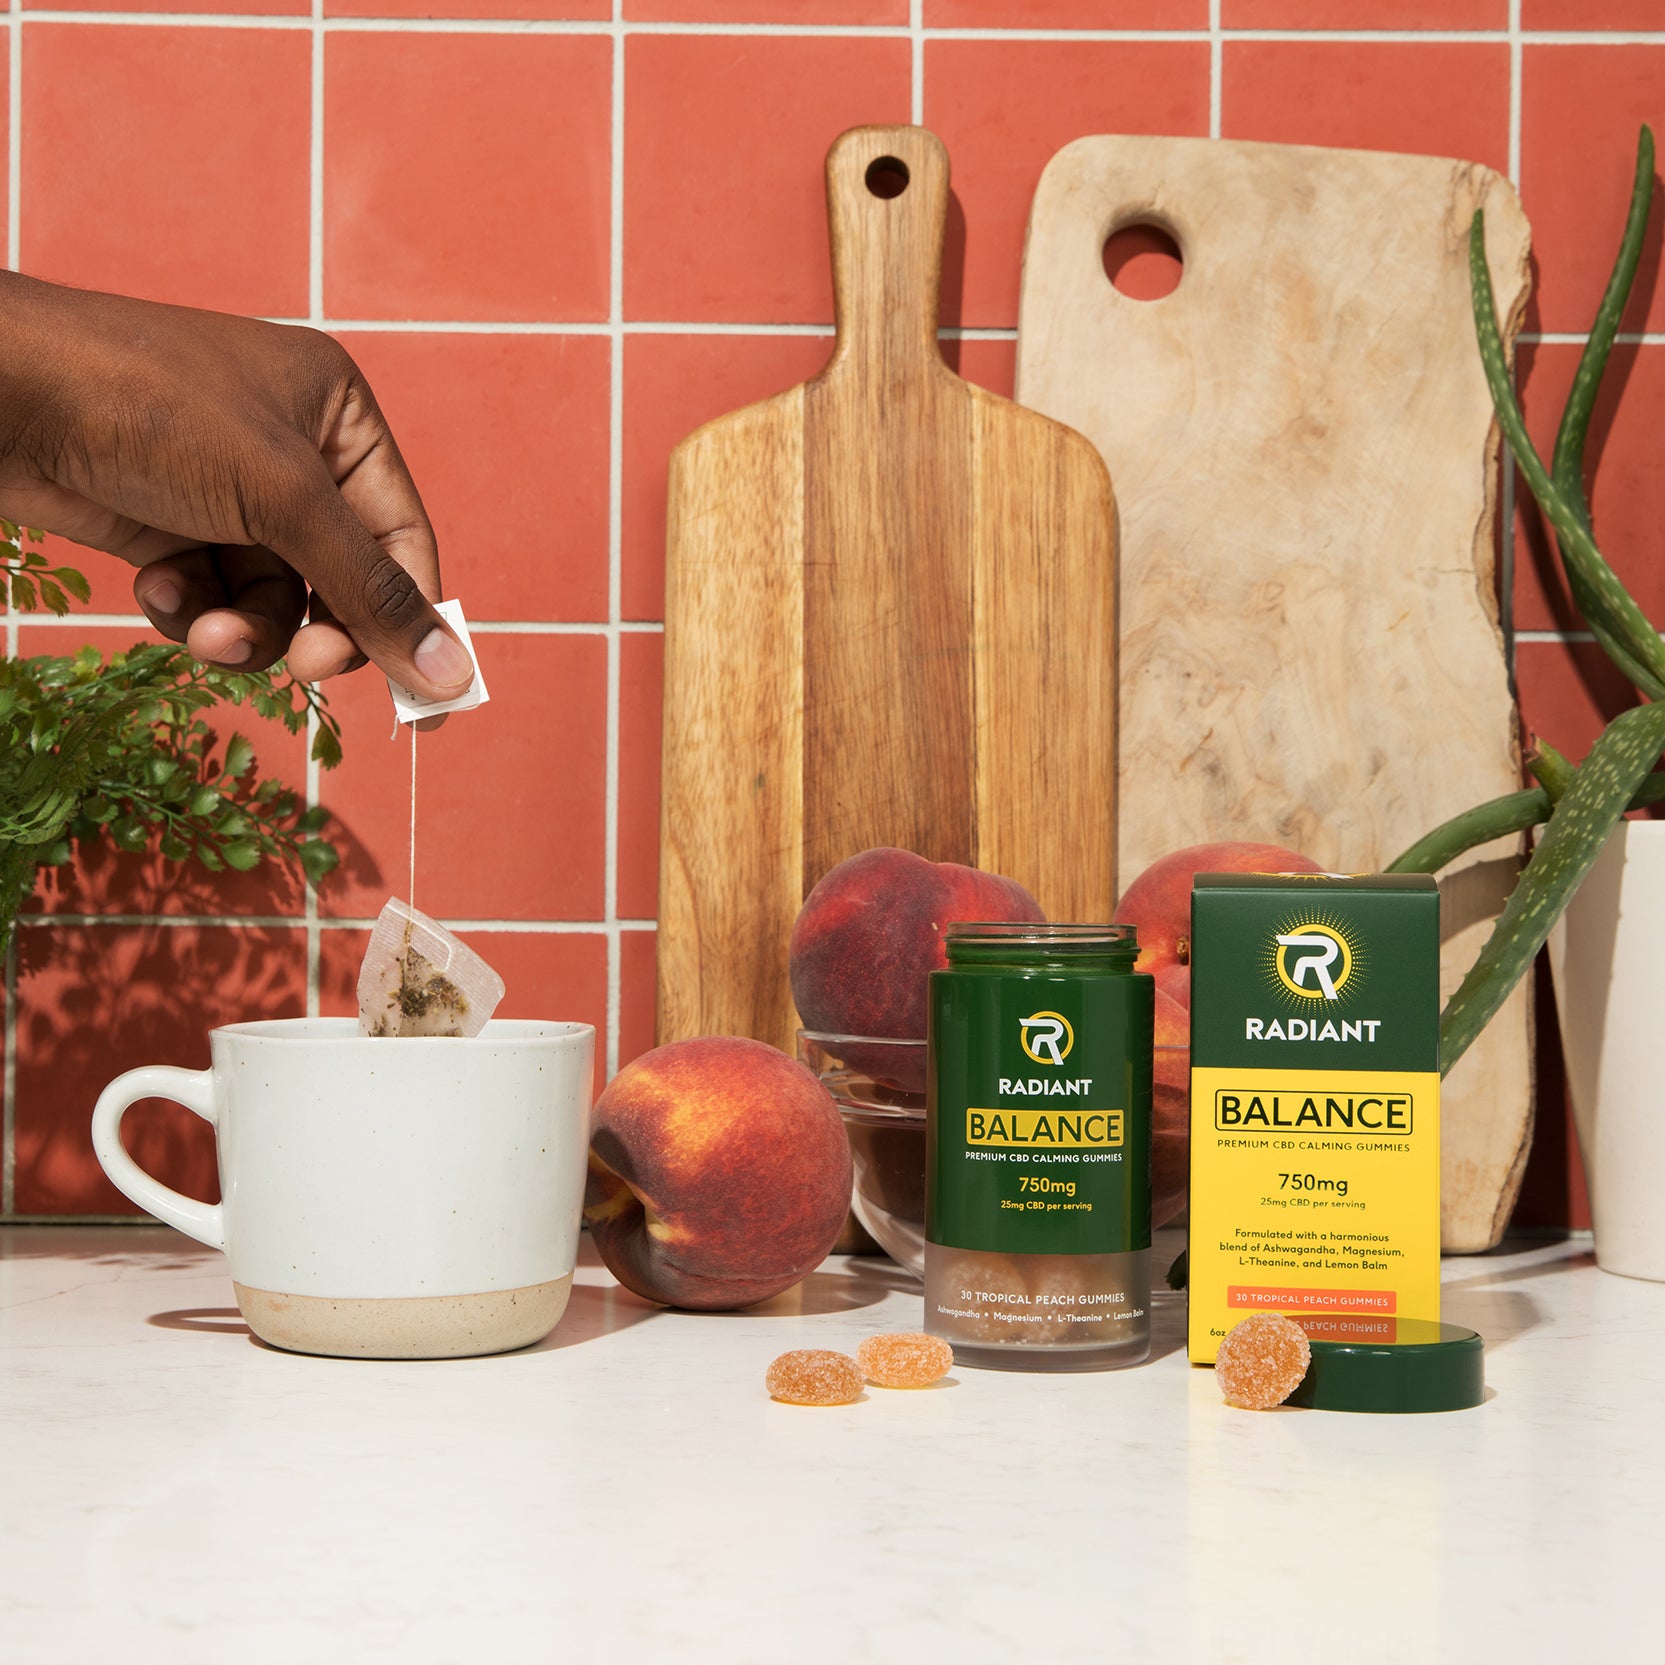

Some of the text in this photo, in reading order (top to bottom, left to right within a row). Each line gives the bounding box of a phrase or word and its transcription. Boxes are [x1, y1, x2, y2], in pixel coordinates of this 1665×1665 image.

[1276, 934, 1339, 1000] R
[1245, 1018, 1381, 1042] RADIANT
[1018, 1018, 1065, 1065] R
[998, 1079, 1093, 1096] RADIANT
[1221, 1095, 1407, 1129] BALANCE
[970, 1113, 1121, 1142] BALANCE
[1217, 1139, 1410, 1152] PREMIUM CBD CALMING GUMMIES
[965, 1151, 1123, 1163] PREMIUM CBD CALMING GUMMIES
[1018, 1177, 1076, 1197] 750mg
[1278, 1173, 1348, 1197] 750mg
[1000, 1200, 1093, 1212] 25mg CBD per serving
[1260, 1198, 1366, 1210] 25mg CBD per serving
[1235, 1228, 1389, 1242] Formulated with a harmonious
[1219, 1242, 1405, 1258] blend of Ashwagandha, Magnesium,
[1239, 1257, 1388, 1270] L-Theanine, and Lemon Balm
[960, 1290, 1125, 1306] 30 TROPICAL PEACH GUMMIES
[1235, 1293, 1389, 1307] 30 TROPICAL PEACH GUMMIES
[993, 1311, 1043, 1324] Magnesium
[1057, 1314, 1103, 1323] L-Theanine
[1113, 1311, 1133, 1321] Lemon
[1209, 1327, 1226, 1337] 6oz
